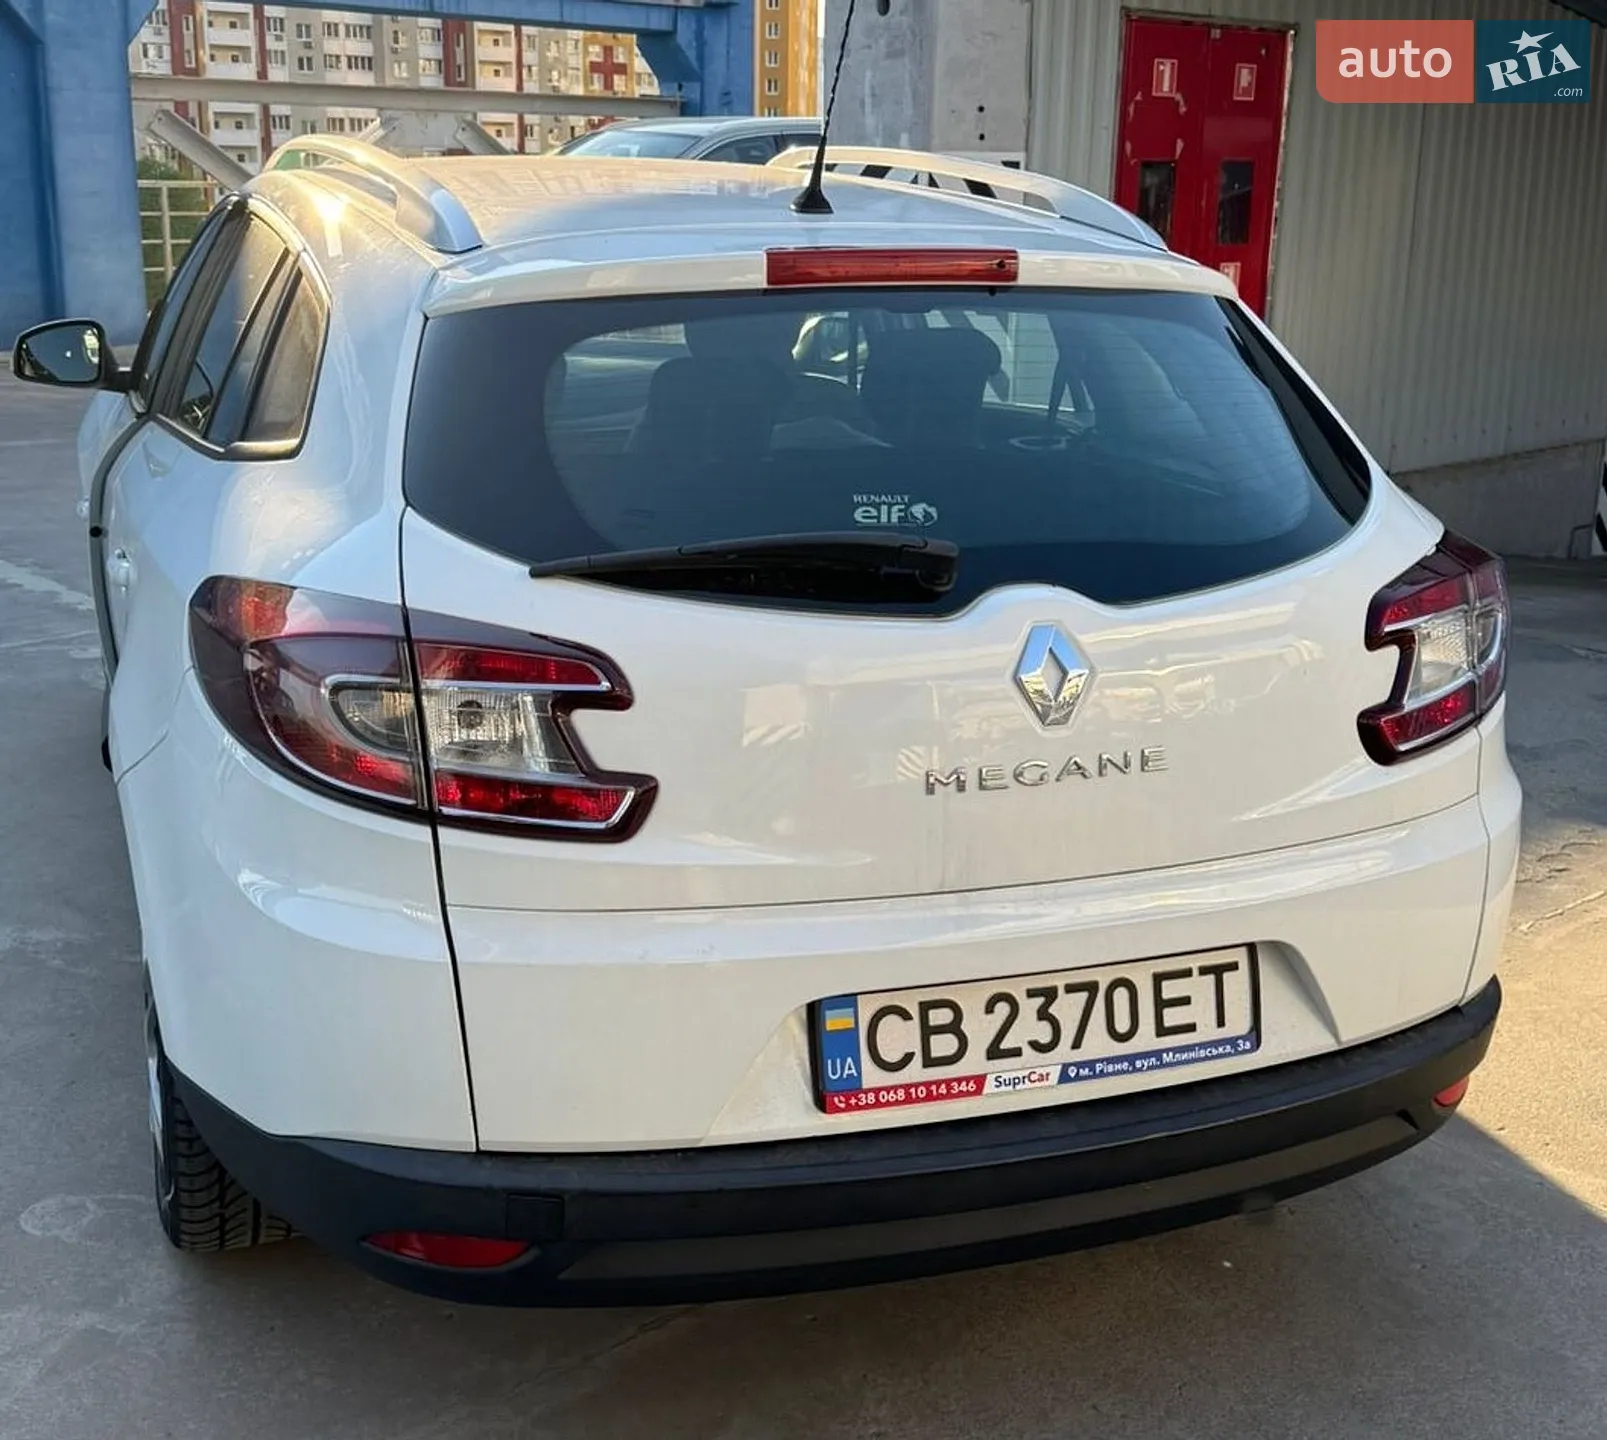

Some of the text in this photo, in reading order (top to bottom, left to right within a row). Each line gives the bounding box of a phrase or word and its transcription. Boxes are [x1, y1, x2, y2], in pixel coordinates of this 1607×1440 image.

[853, 494, 909, 503] RENAULT
[854, 504, 905, 523] elf
[925, 745, 1169, 796] MEGANE
[866, 961, 1240, 1073] CB 2370 ET
[827, 1058, 857, 1080] UA
[1095, 1062, 1133, 1075] Рівне,
[1135, 1058, 1160, 1071] вул.
[1162, 1044, 1235, 1064] Млинівська,
[994, 1071, 1051, 1089] SuprCar
[850, 1080, 977, 1106] +38 068 10 14 346
